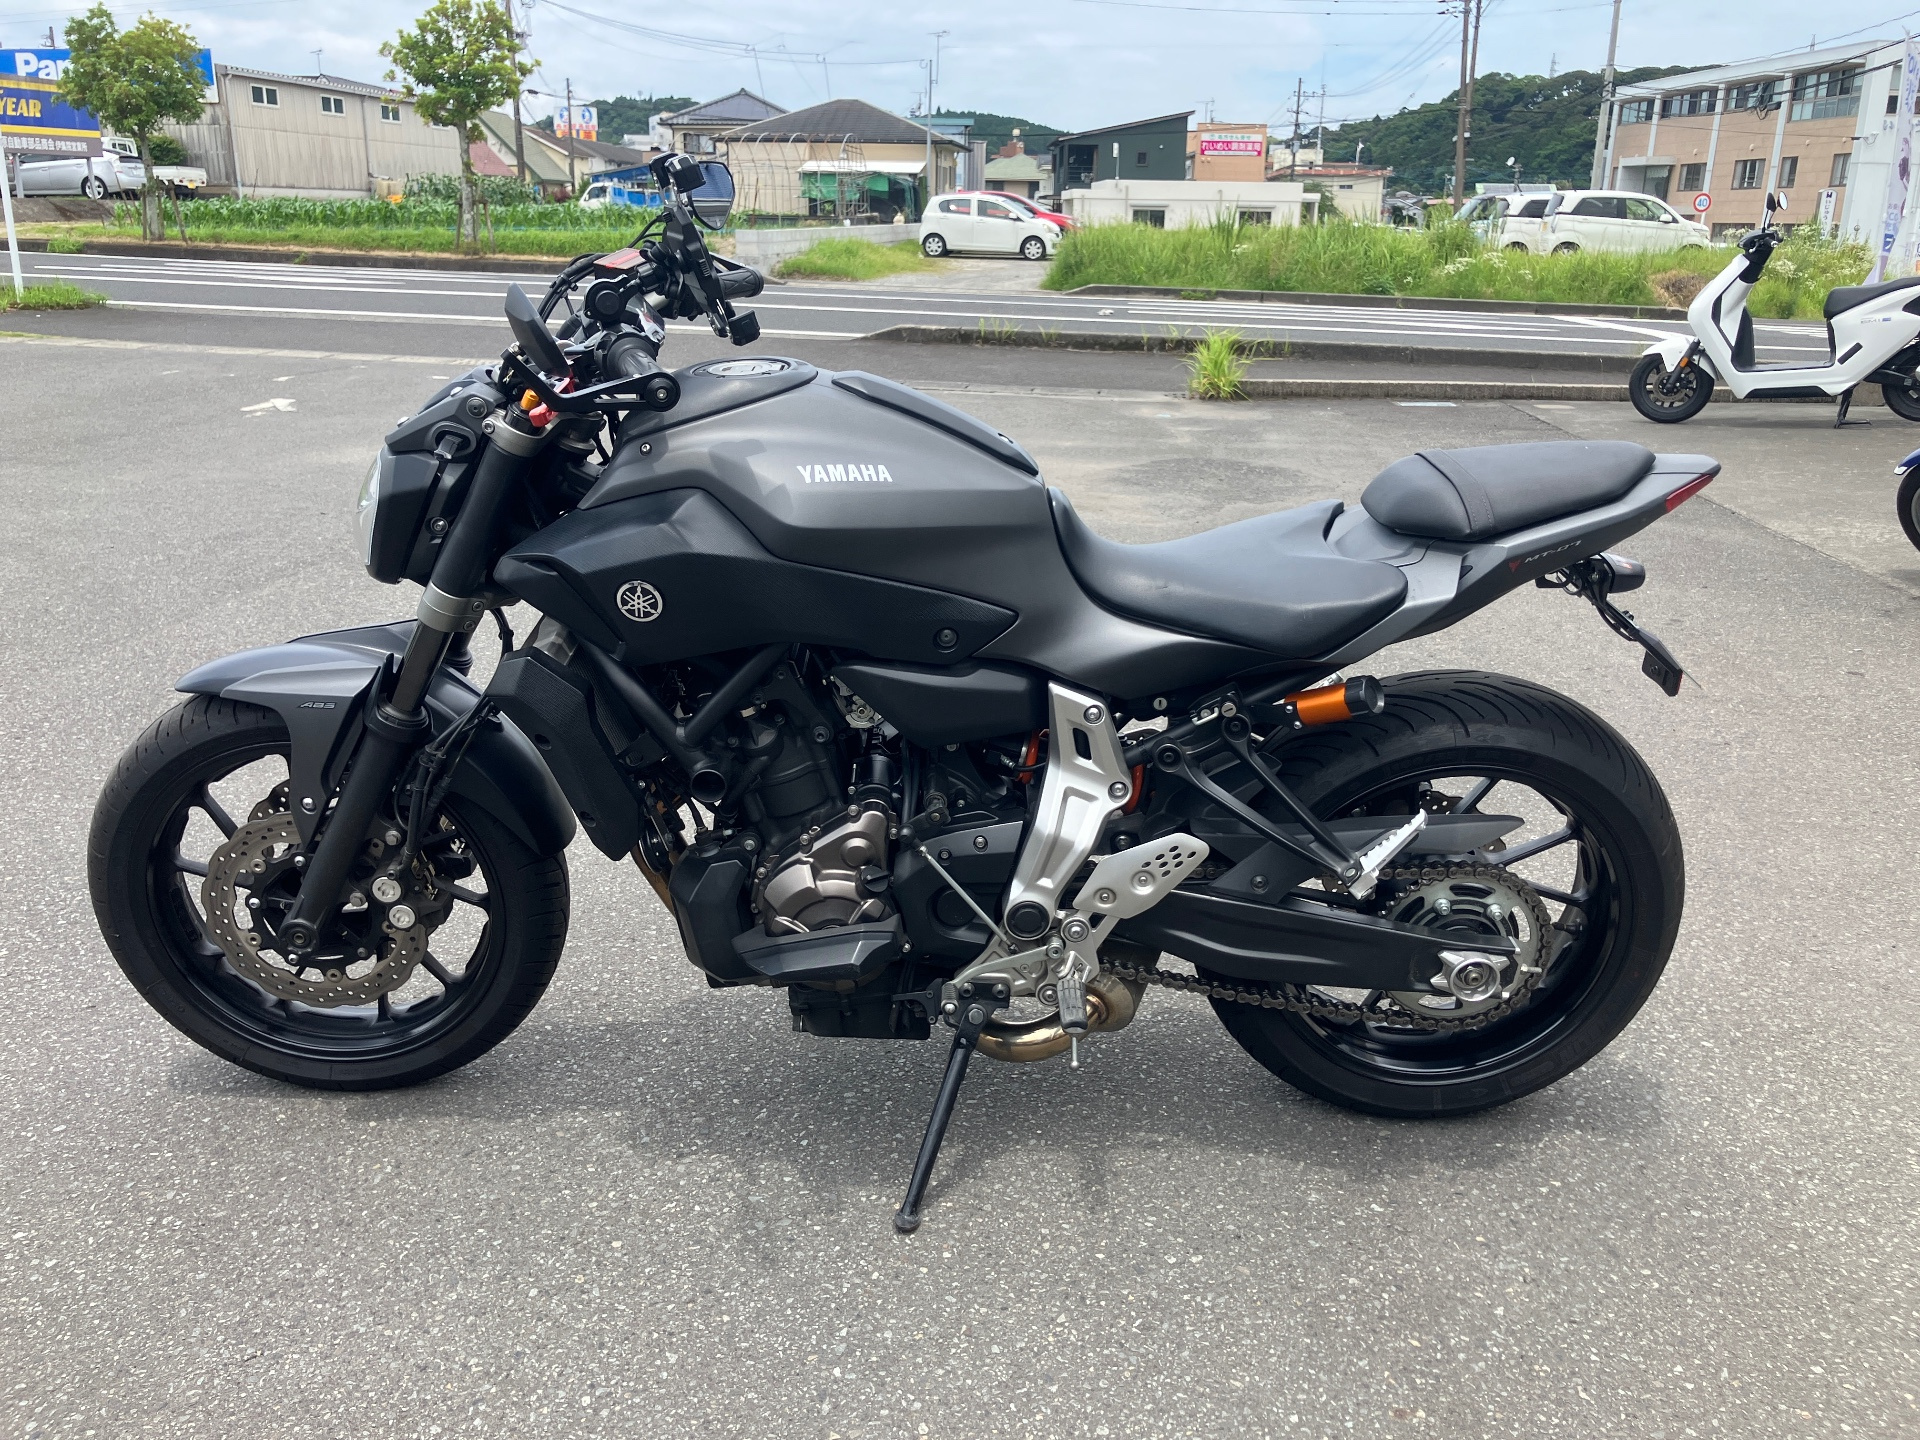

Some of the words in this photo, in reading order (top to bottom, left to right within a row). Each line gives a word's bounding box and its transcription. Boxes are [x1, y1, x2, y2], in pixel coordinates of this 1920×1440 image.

[1697, 198, 1708, 207] 40
[796, 464, 893, 484] YAMAHA
[1523, 540, 1582, 564] MT-07
[299, 701, 336, 709] ABS
